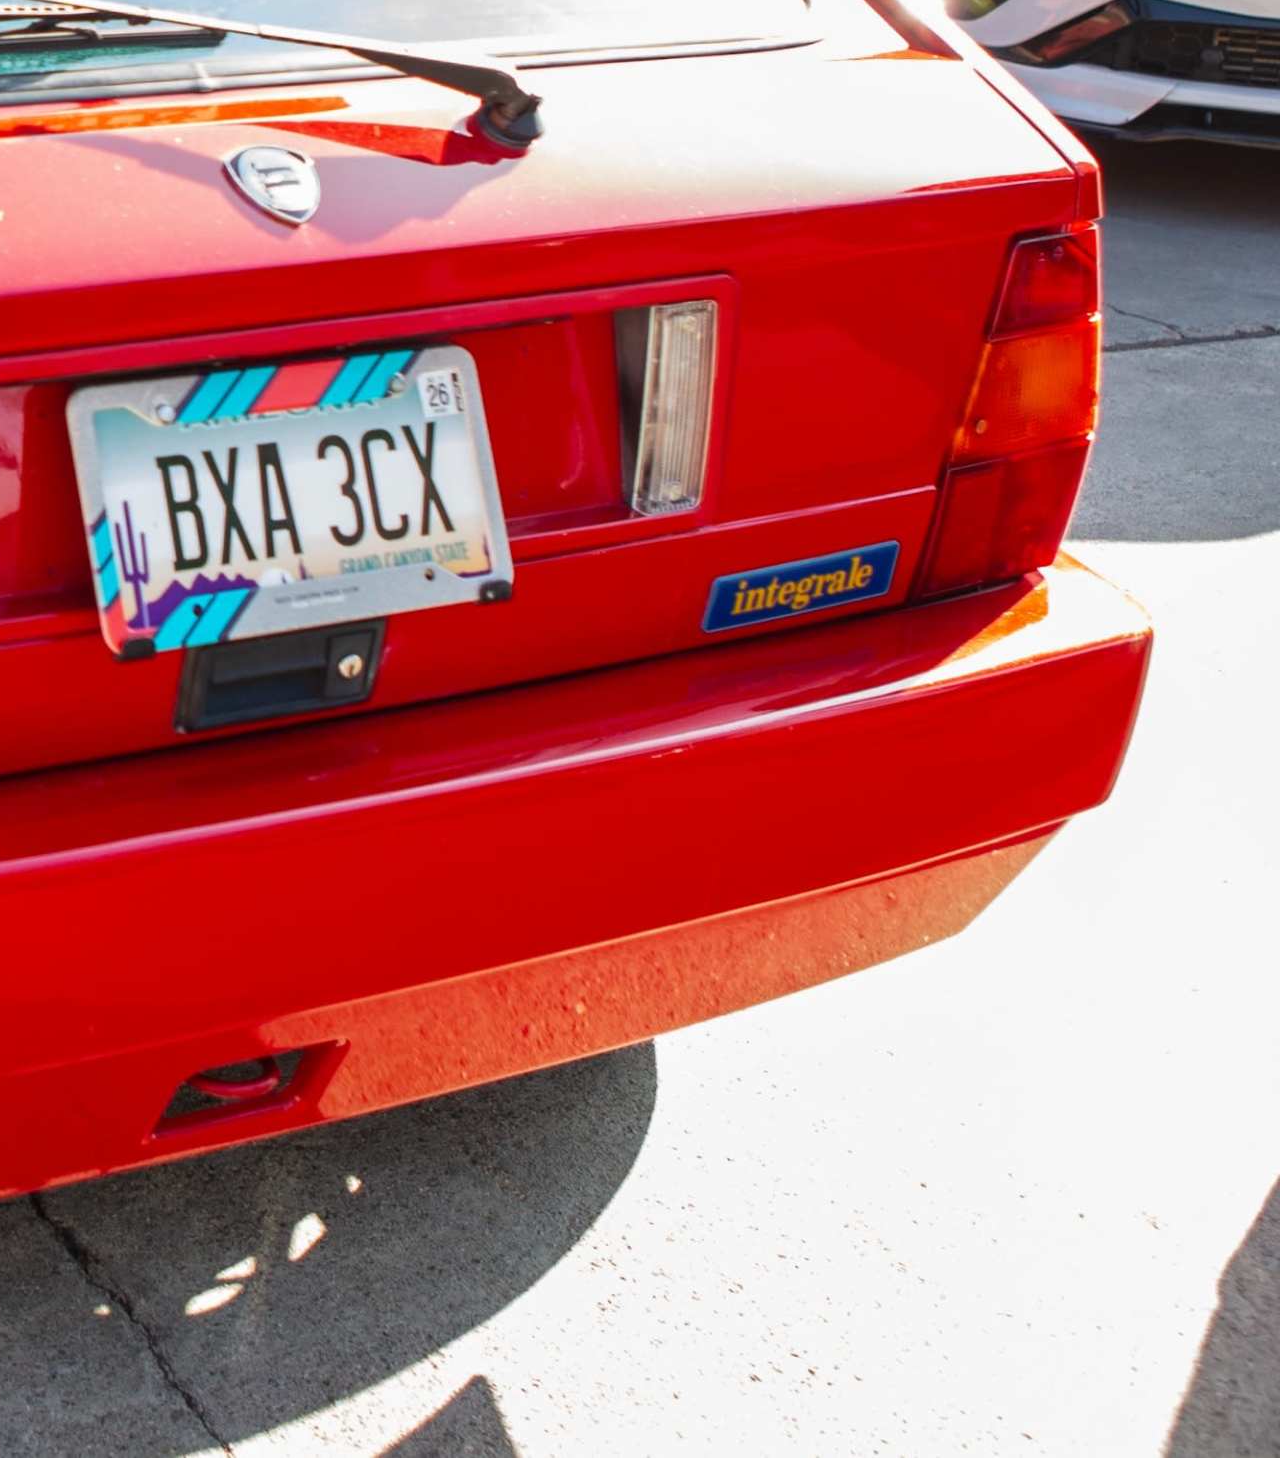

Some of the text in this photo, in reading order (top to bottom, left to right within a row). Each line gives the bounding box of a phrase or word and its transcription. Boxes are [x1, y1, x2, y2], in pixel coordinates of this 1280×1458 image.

[155, 422, 456, 571] BXA 3CX
[340, 553, 382, 574] GRAND
[435, 542, 471, 563] STATE
[730, 555, 874, 616] integrale
